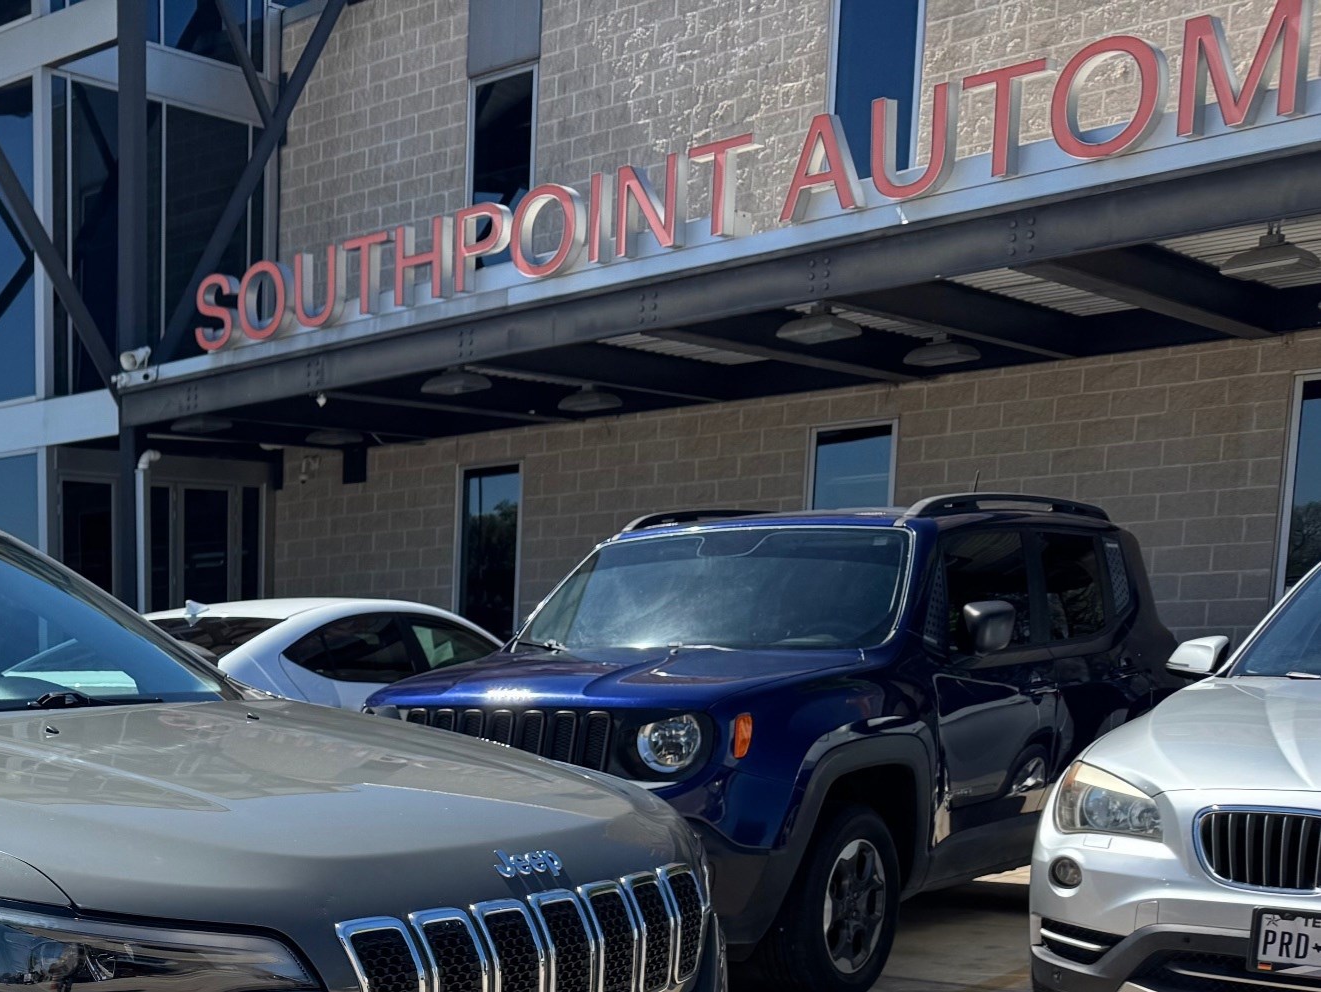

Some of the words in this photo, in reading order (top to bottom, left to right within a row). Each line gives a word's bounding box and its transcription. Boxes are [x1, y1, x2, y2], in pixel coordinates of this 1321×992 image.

[195, 133, 761, 351] SOUTHPOINT
[779, 0, 1311, 222] AUTOM
[493, 849, 562, 878] Jeep
[1262, 929, 1310, 959] PRD
